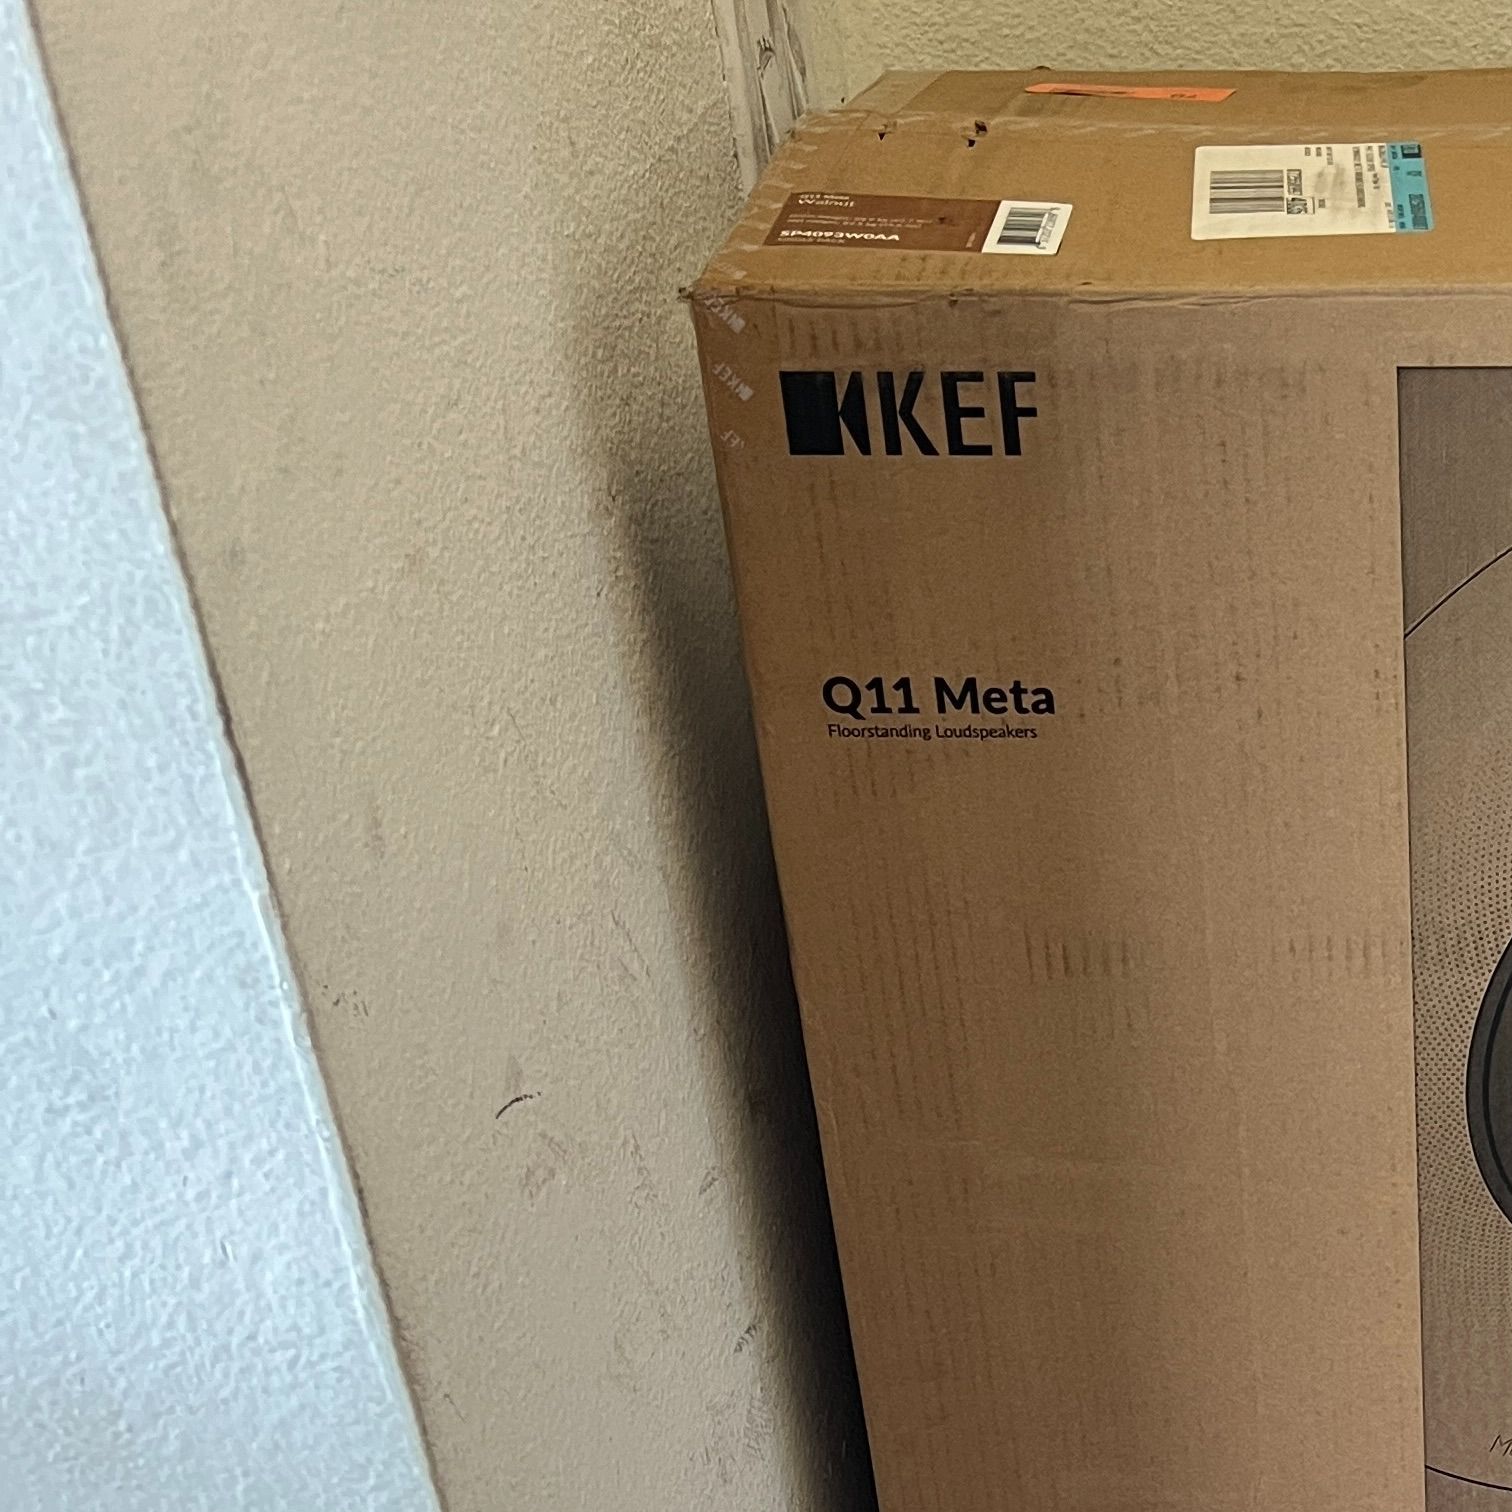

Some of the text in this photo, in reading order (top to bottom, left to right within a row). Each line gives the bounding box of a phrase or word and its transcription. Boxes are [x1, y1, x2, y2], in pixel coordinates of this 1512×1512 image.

[876, 371, 1038, 456] KEF
[821, 675, 1056, 721] Q11 Meta
[827, 723, 1038, 742] Floorstanding Loudspeakers
